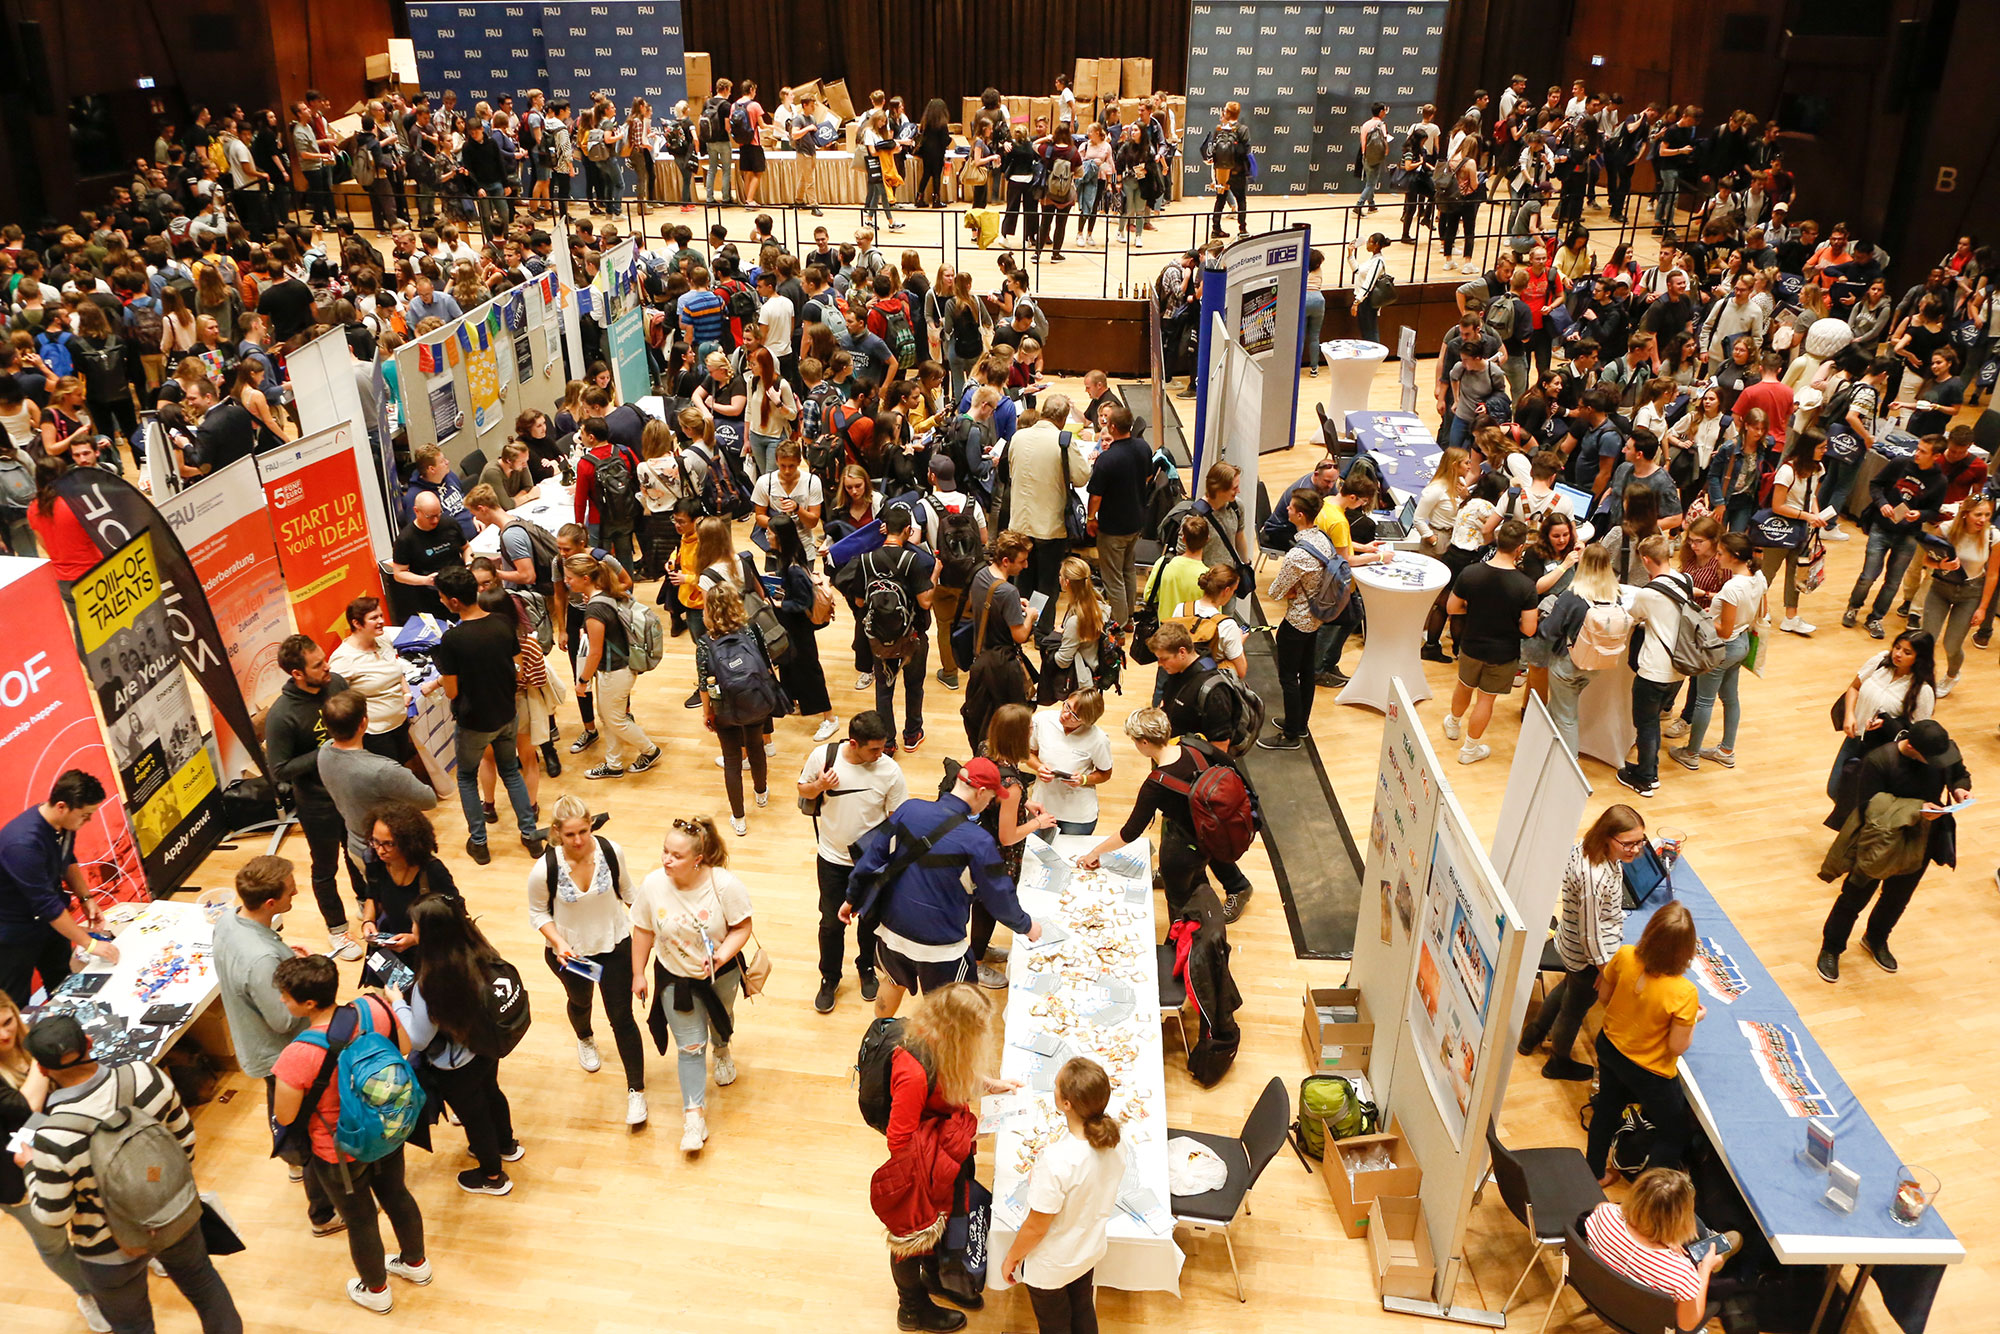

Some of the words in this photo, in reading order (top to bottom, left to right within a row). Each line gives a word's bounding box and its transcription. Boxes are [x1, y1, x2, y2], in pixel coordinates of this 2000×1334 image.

[409, 8, 428, 18] FAU
[458, 8, 476, 17] FAU
[505, 7, 524, 17] FAU
[543, 6, 561, 16] FAU
[590, 6, 608, 16] FAU
[637, 5, 655, 16] FAU
[1194, 5, 1211, 15] FAU
[1239, 5, 1256, 15] FAU
[1284, 6, 1301, 15] FAU
[1324, 5, 1335, 15] AU
[1362, 6, 1379, 15] FAU
[1406, 6, 1424, 15] FAU
[437, 29, 455, 39] FAU
[484, 28, 503, 38] FAU
[532, 28, 544, 37] FA
[569, 27, 587, 37] FAU
[615, 26, 634, 36] FAU
[662, 26, 680, 36] FAU
[1215, 25, 1233, 36] FAU
[1259, 26, 1277, 36] FAU
[1304, 26, 1322, 36] FAU
[1338, 26, 1356, 36] FAU
[1382, 26, 1399, 36] FAU
[1426, 26, 1443, 36] FAU
[416, 50, 435, 59] FAU
[464, 49, 482, 59] FAU
[511, 48, 529, 58] FAU
[548, 48, 566, 58] FAU
[594, 47, 612, 57] FAU
[640, 46, 659, 56] FAU
[1191, 46, 1209, 56] FAU
[1236, 46, 1253, 56] FAU
[1280, 46, 1298, 56] FAU
[1320, 46, 1332, 56] AU
[1358, 46, 1375, 56] FAU
[1402, 46, 1419, 56] FAU
[443, 70, 461, 79] FAU
[490, 69, 508, 78] FAU
[537, 69, 549, 78] FA
[573, 68, 591, 78] FAU
[619, 67, 637, 77] FAU
[665, 66, 683, 76] FAU
[1212, 66, 1230, 76] FAU
[1256, 66, 1274, 76] FAU
[1300, 66, 1318, 76] FAU
[1334, 66, 1351, 76] FAU
[1377, 66, 1395, 76] FAU
[1421, 66, 1438, 76] FAU
[470, 90, 488, 99] FAU
[553, 88, 571, 98] FAU
[644, 86, 662, 96] FAU
[1189, 86, 1206, 96] FAU
[1233, 86, 1250, 96] FAU
[1277, 86, 1294, 96] FAU
[1316, 86, 1328, 95] AU
[1354, 86, 1371, 95] FAU
[1397, 86, 1414, 95] FAU
[1209, 106, 1222, 116] FA
[1253, 106, 1270, 115] FAU
[1297, 106, 1314, 115] FAU
[1330, 106, 1347, 115] FAU
[1186, 126, 1203, 136] FAU
[1273, 126, 1290, 135] FAU
[1313, 125, 1324, 134] AU
[1350, 125, 1361, 134] FA
[1250, 145, 1267, 154] FAU
[1293, 145, 1310, 154] FAU
[1326, 144, 1343, 153] FAU
[1184, 165, 1200, 174] FAU
[1270, 164, 1287, 173] FAU
[1309, 163, 1320, 172] AU
[1935, 166, 1958, 193] B
[1247, 183, 1263, 192] FAU
[1289, 183, 1306, 192] FAU
[1323, 182, 1339, 191] FAU
[264, 460, 280, 473] FAU
[273, 487, 288, 510] 5
[166, 502, 196, 530] FAU
[280, 503, 330, 542] START
[334, 492, 357, 517] UP
[285, 534, 316, 556] YOUR
[318, 511, 365, 549] IDEA!
[0, 650, 52, 708] OF
[115, 680, 139, 712] Are
[138, 654, 177, 685] You...
[162, 833, 190, 865] Apply
[189, 809, 211, 838] now!
